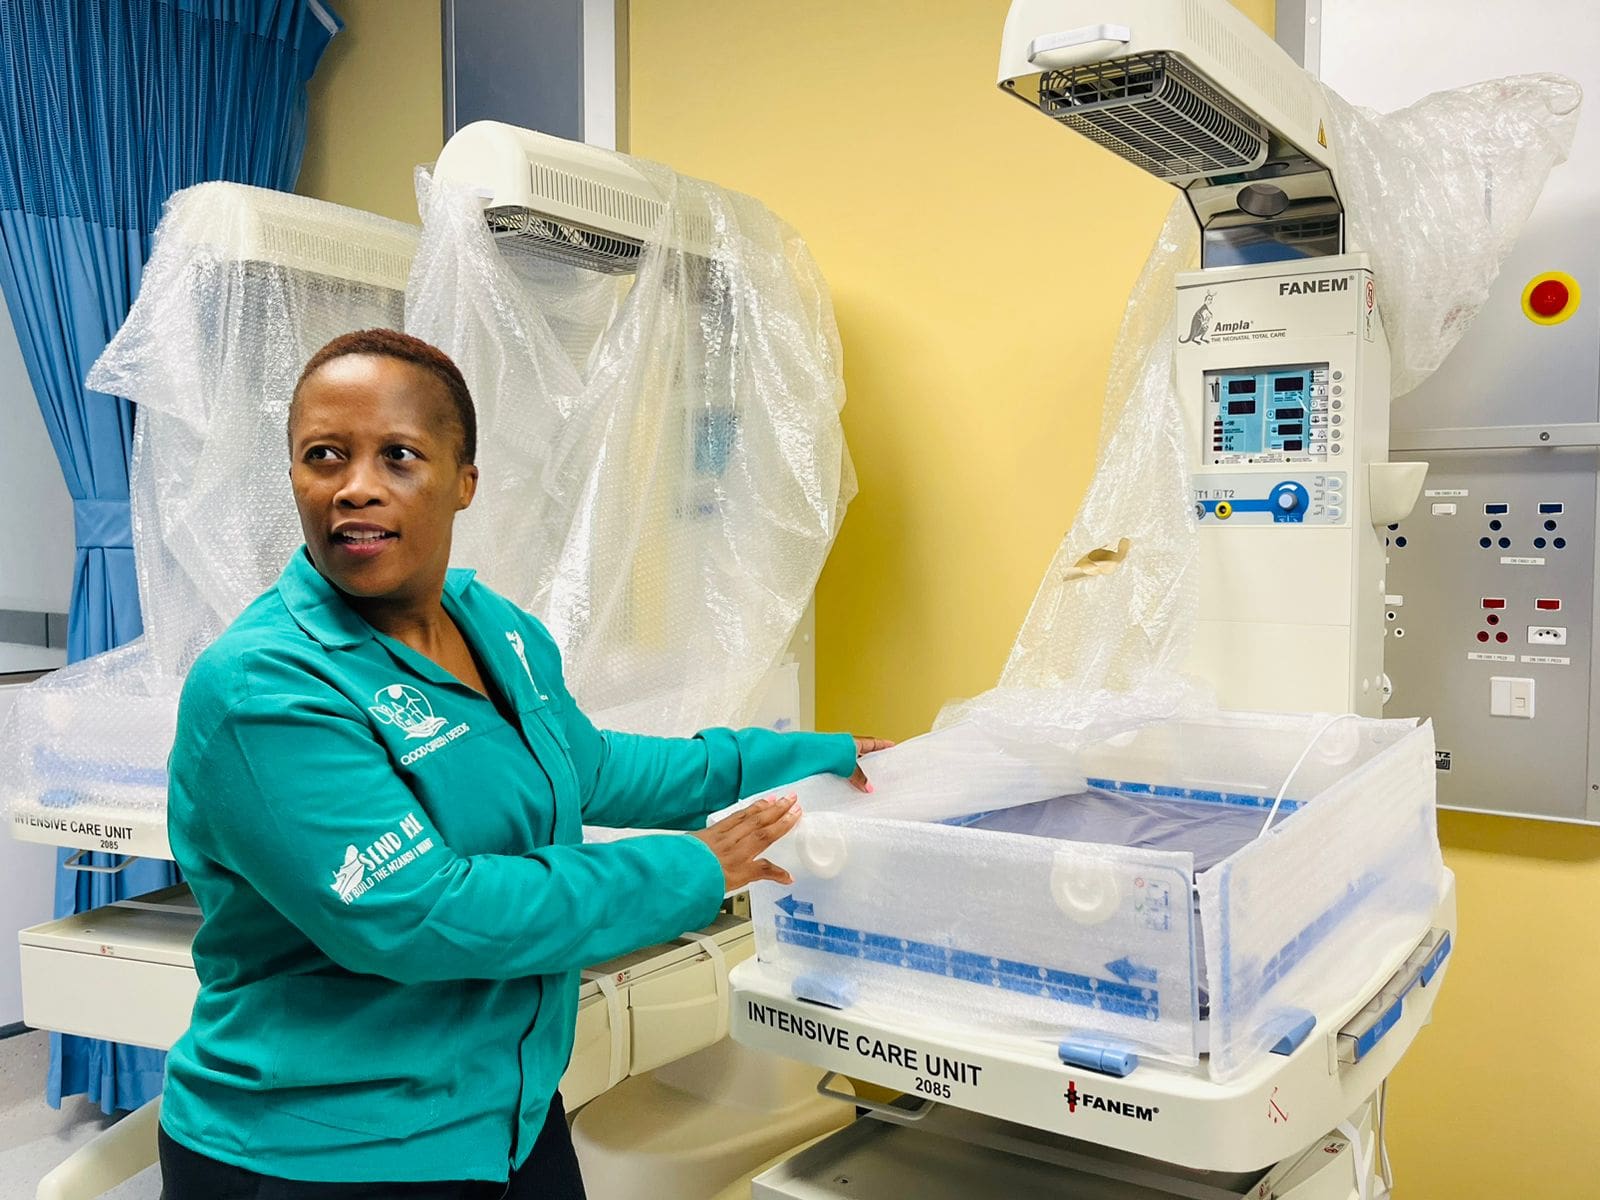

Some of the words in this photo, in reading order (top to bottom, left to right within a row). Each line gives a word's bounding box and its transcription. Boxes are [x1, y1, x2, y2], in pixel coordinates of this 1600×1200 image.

[1224, 490, 1235, 498] T2
[14, 812, 67, 832] INTENSIVE
[70, 820, 102, 837] CARE
[105, 825, 133, 840] UNIT
[100, 839, 119, 850] 2085
[358, 831, 402, 872] SEND
[353, 876, 375, 899] BUILD
[371, 866, 390, 883] THE
[748, 1001, 850, 1051] INTENSIVE
[856, 1035, 918, 1071] CARE
[925, 1054, 982, 1087] UNIT
[914, 1076, 951, 1099] 2085
